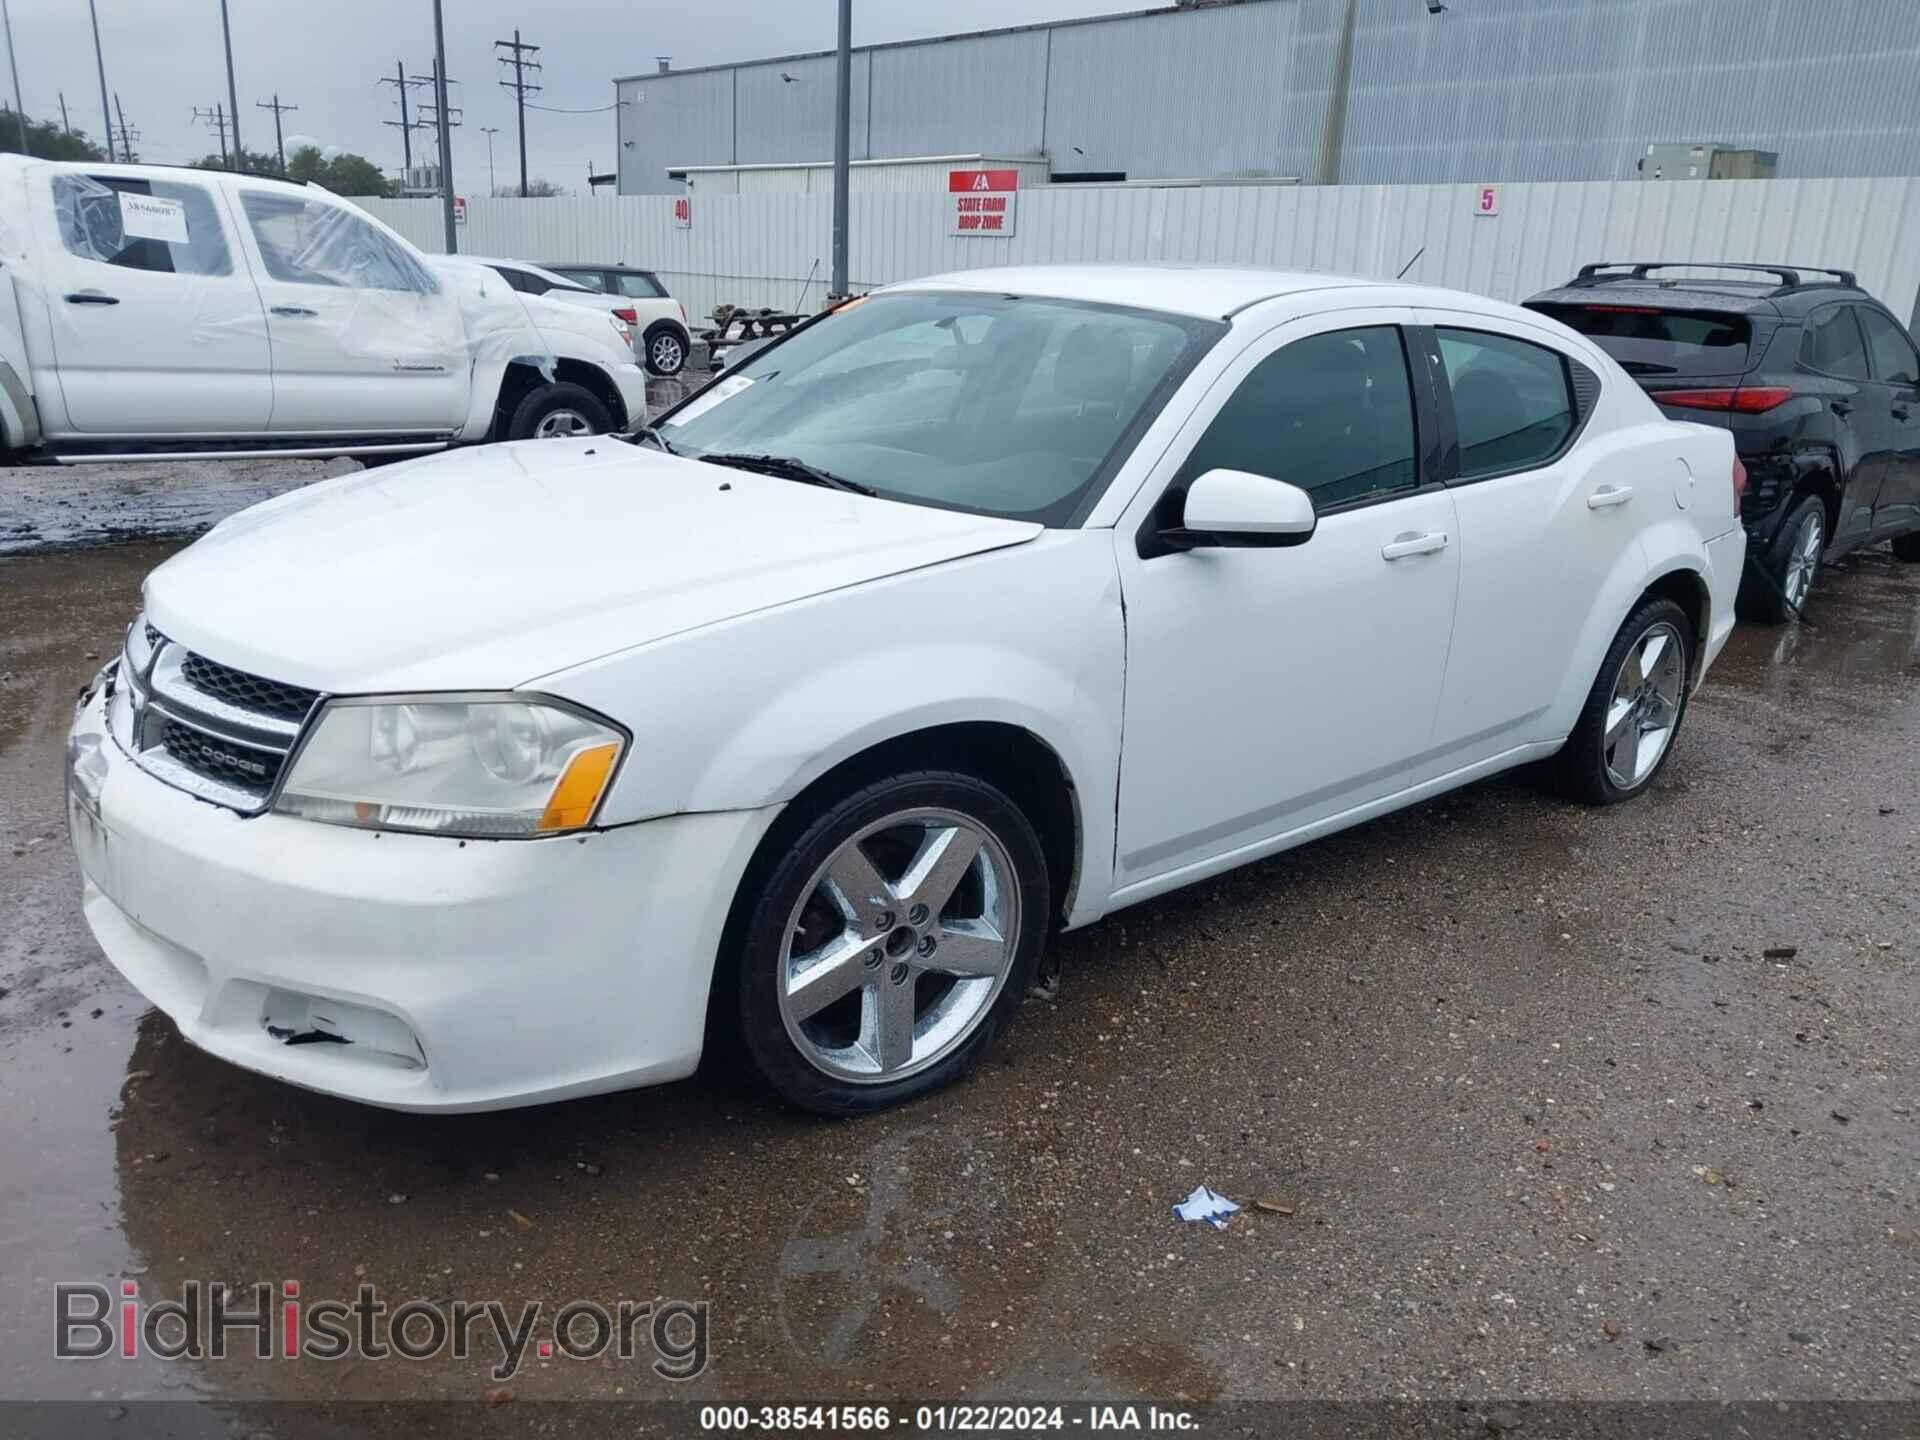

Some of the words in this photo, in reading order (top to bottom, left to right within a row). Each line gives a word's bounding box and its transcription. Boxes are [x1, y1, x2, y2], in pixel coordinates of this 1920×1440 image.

[675, 199, 688, 220] 40
[957, 197, 981, 212] STATE
[982, 197, 1006, 212] FARM
[1481, 189, 1494, 210] 5
[958, 215, 981, 229] DROP
[981, 215, 1004, 229] ZONE
[201, 745, 266, 775] DODGE
